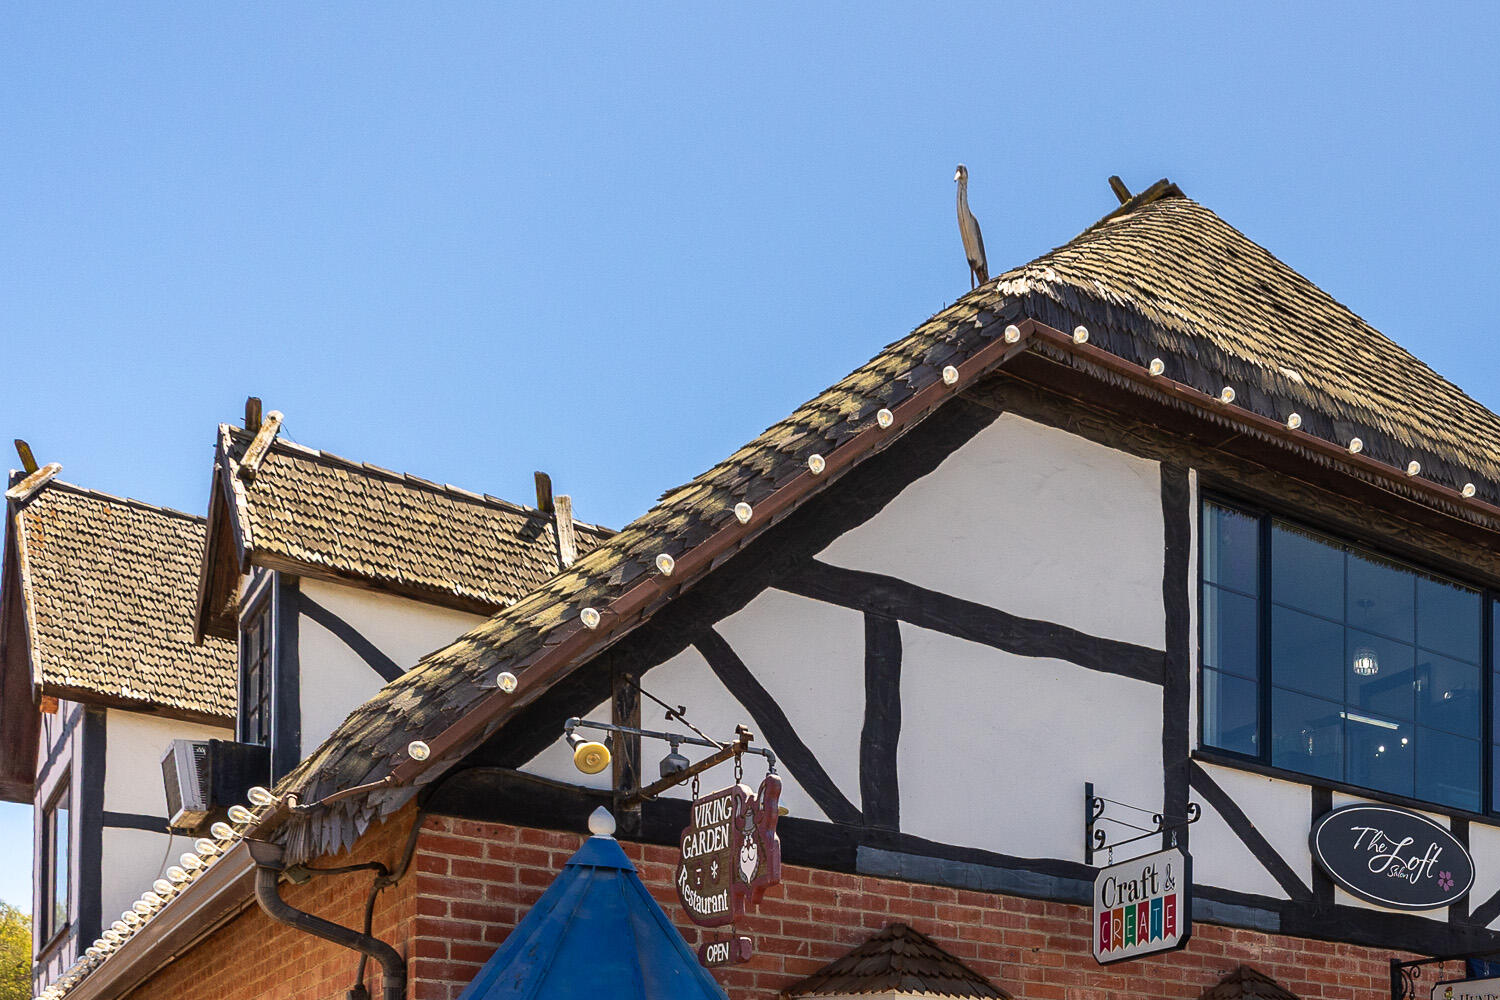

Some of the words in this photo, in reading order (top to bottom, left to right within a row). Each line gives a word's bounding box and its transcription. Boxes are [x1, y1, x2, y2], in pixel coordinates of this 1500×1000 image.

[694, 794, 732, 829] VIKING
[682, 823, 730, 861] GARDEN
[1350, 826, 1387, 854] The
[1368, 837, 1443, 885] Loft
[1387, 865, 1409, 880] Salon
[678, 865, 729, 915] Restaurant
[1101, 862, 1159, 909] Craft
[1164, 863, 1176, 892] &
[1101, 904, 1174, 944] CREATE
[706, 941, 729, 963] OPEN
